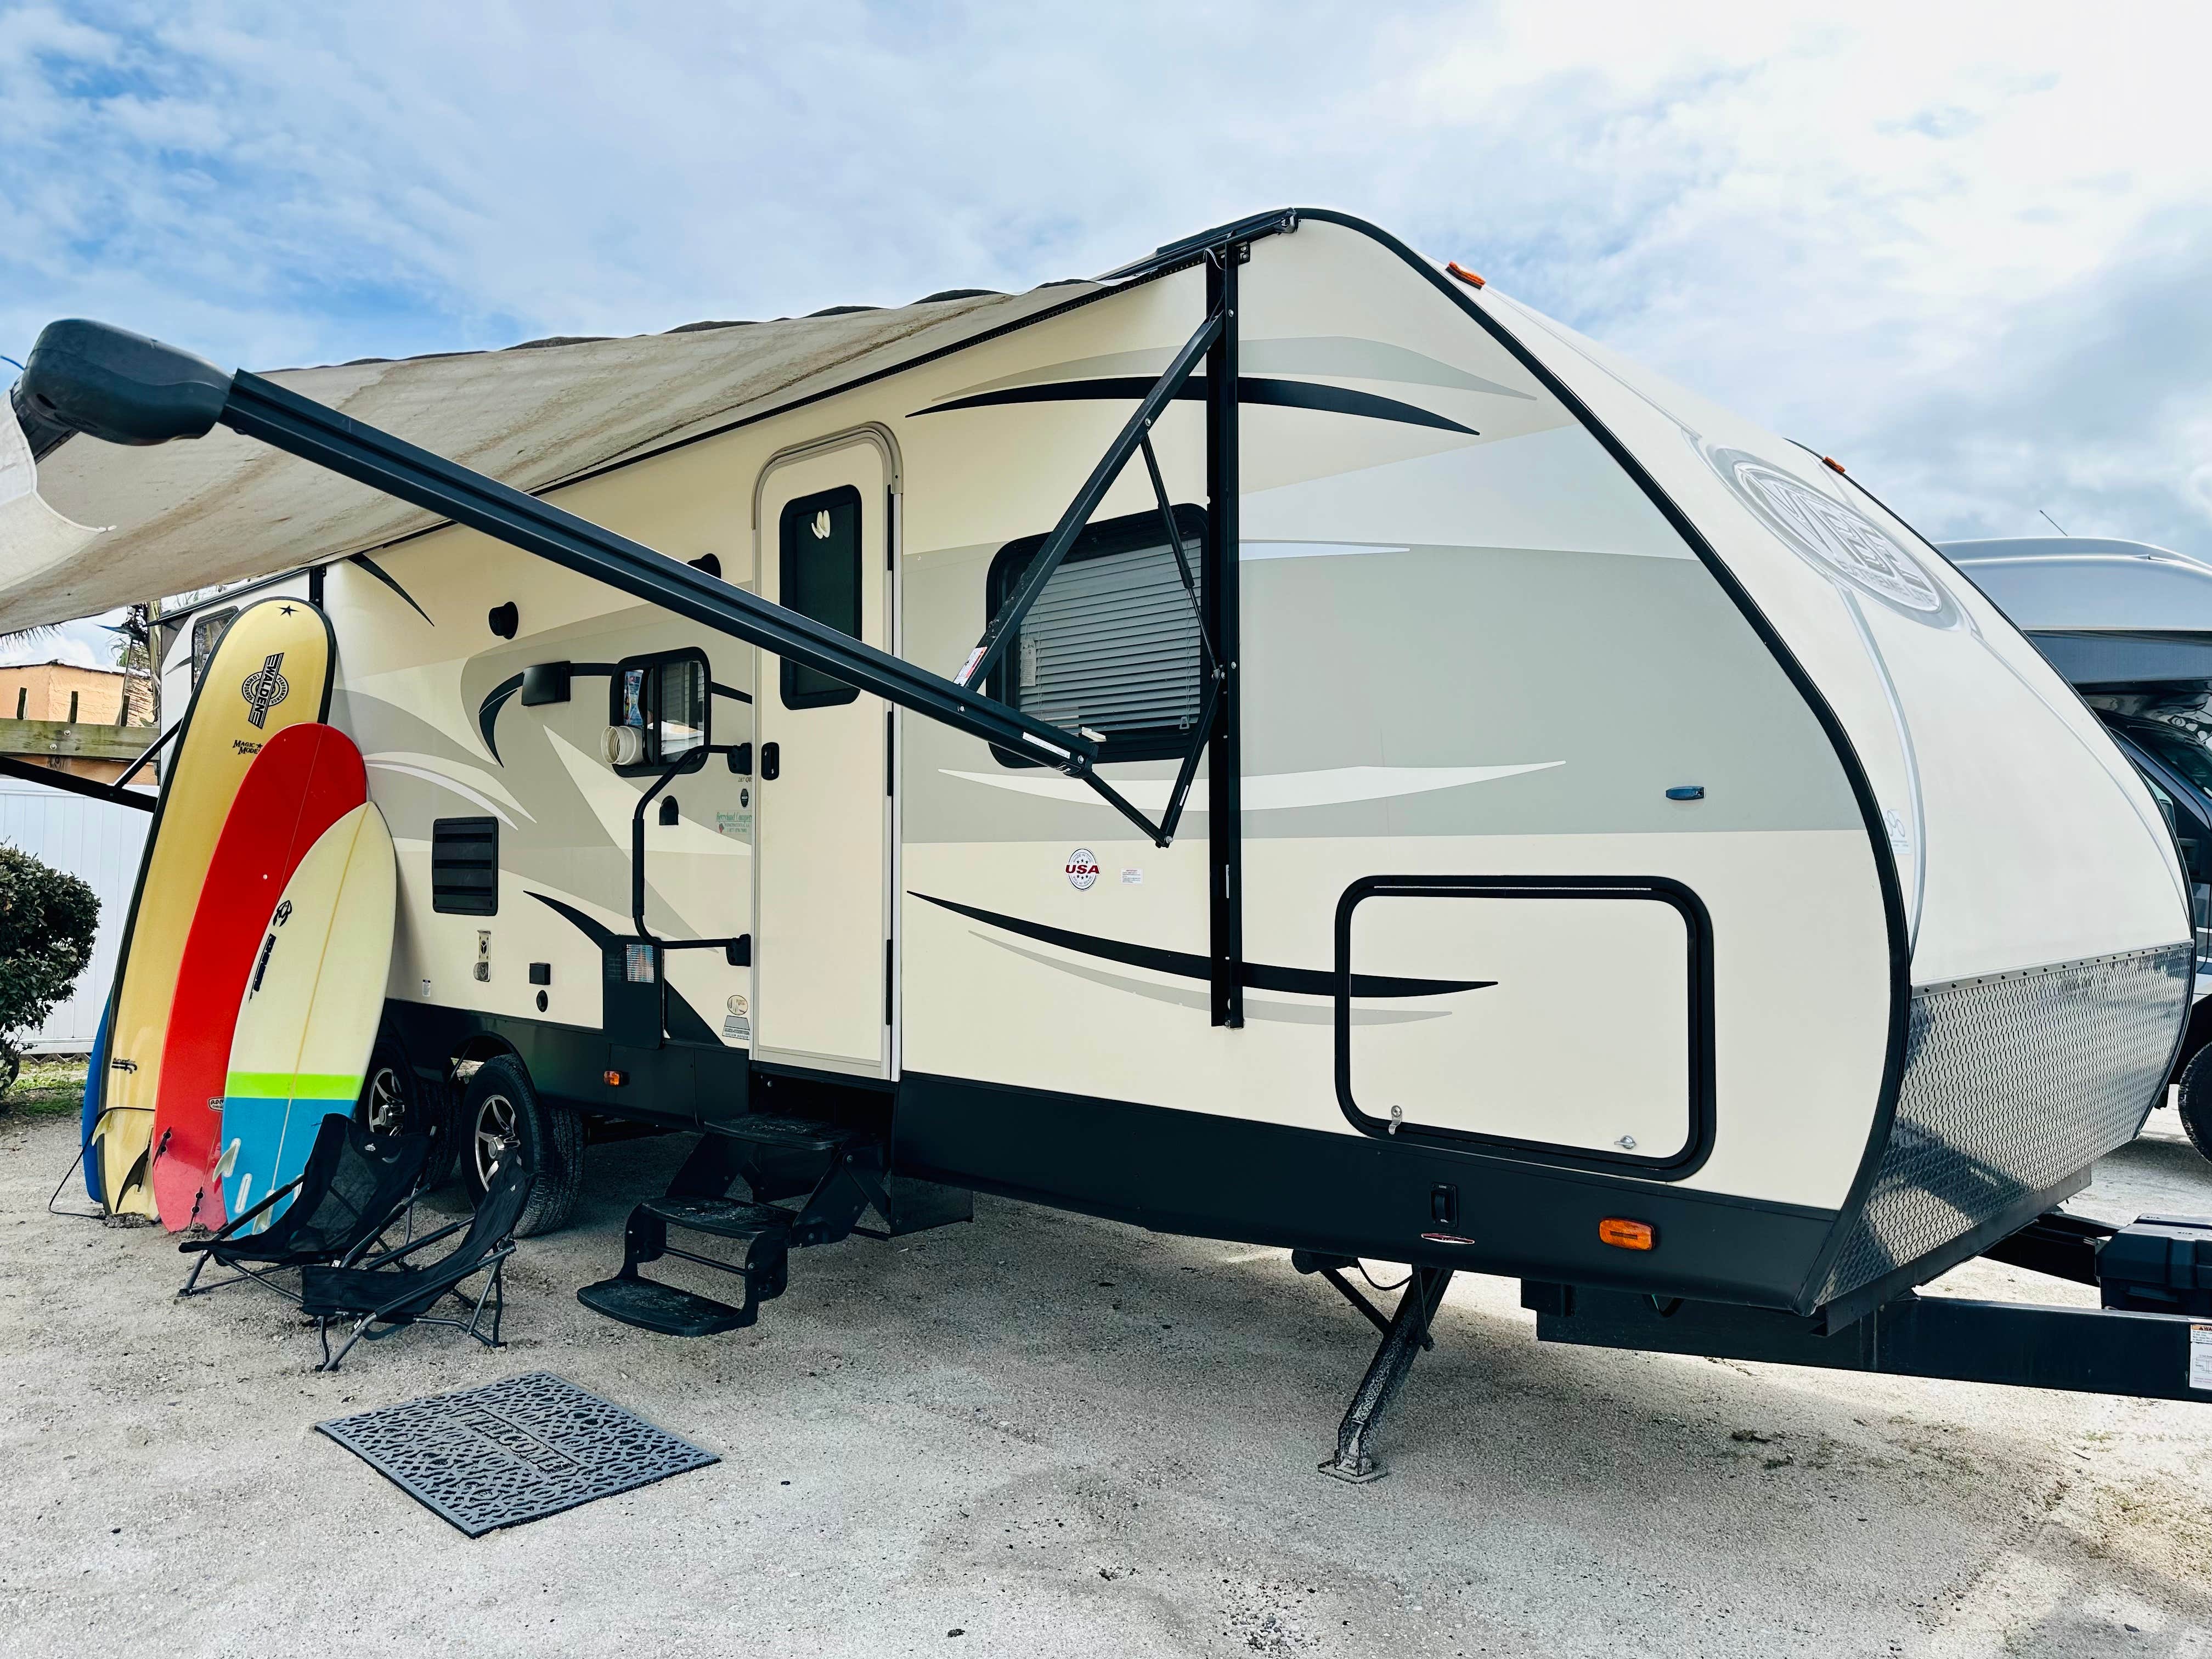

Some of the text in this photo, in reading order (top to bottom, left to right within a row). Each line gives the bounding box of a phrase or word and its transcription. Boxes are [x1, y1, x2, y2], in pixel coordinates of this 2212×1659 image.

[244, 673, 261, 701] LONGBOARDS
[254, 665, 276, 713] WALDEN
[270, 677, 286, 704] PERFORMANCE
[1065, 864, 1100, 874] USA
[460, 1412, 577, 1473] WELCOME
